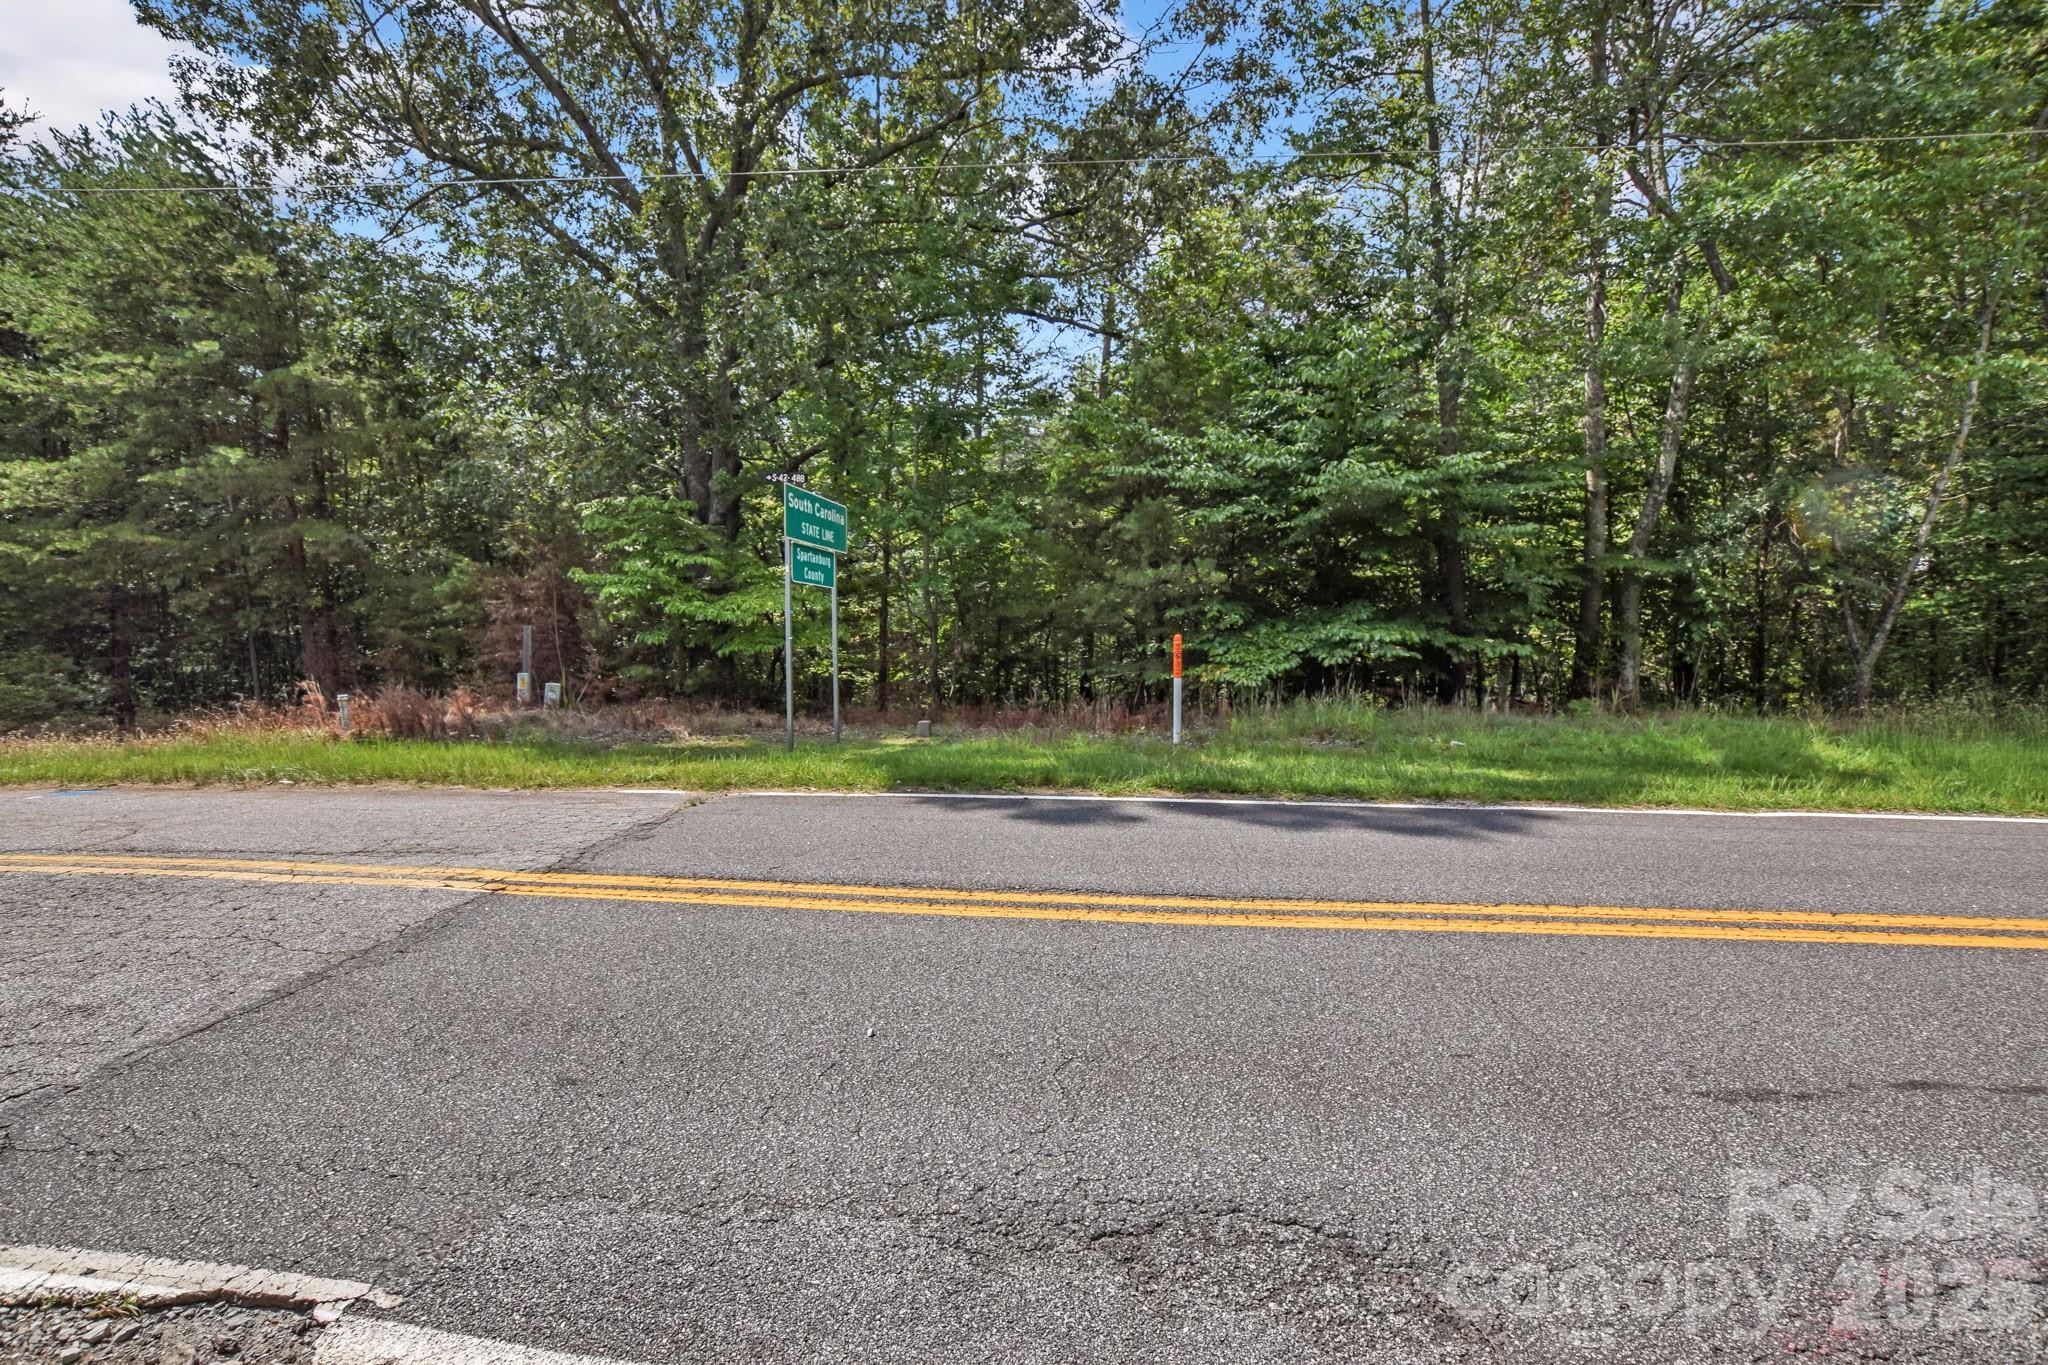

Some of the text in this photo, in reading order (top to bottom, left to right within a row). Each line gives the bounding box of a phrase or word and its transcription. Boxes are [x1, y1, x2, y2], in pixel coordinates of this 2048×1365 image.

[788, 492, 845, 526] South Carolina
[801, 521, 835, 543] STATE LINE
[796, 548, 831, 583] Spartanburg County
